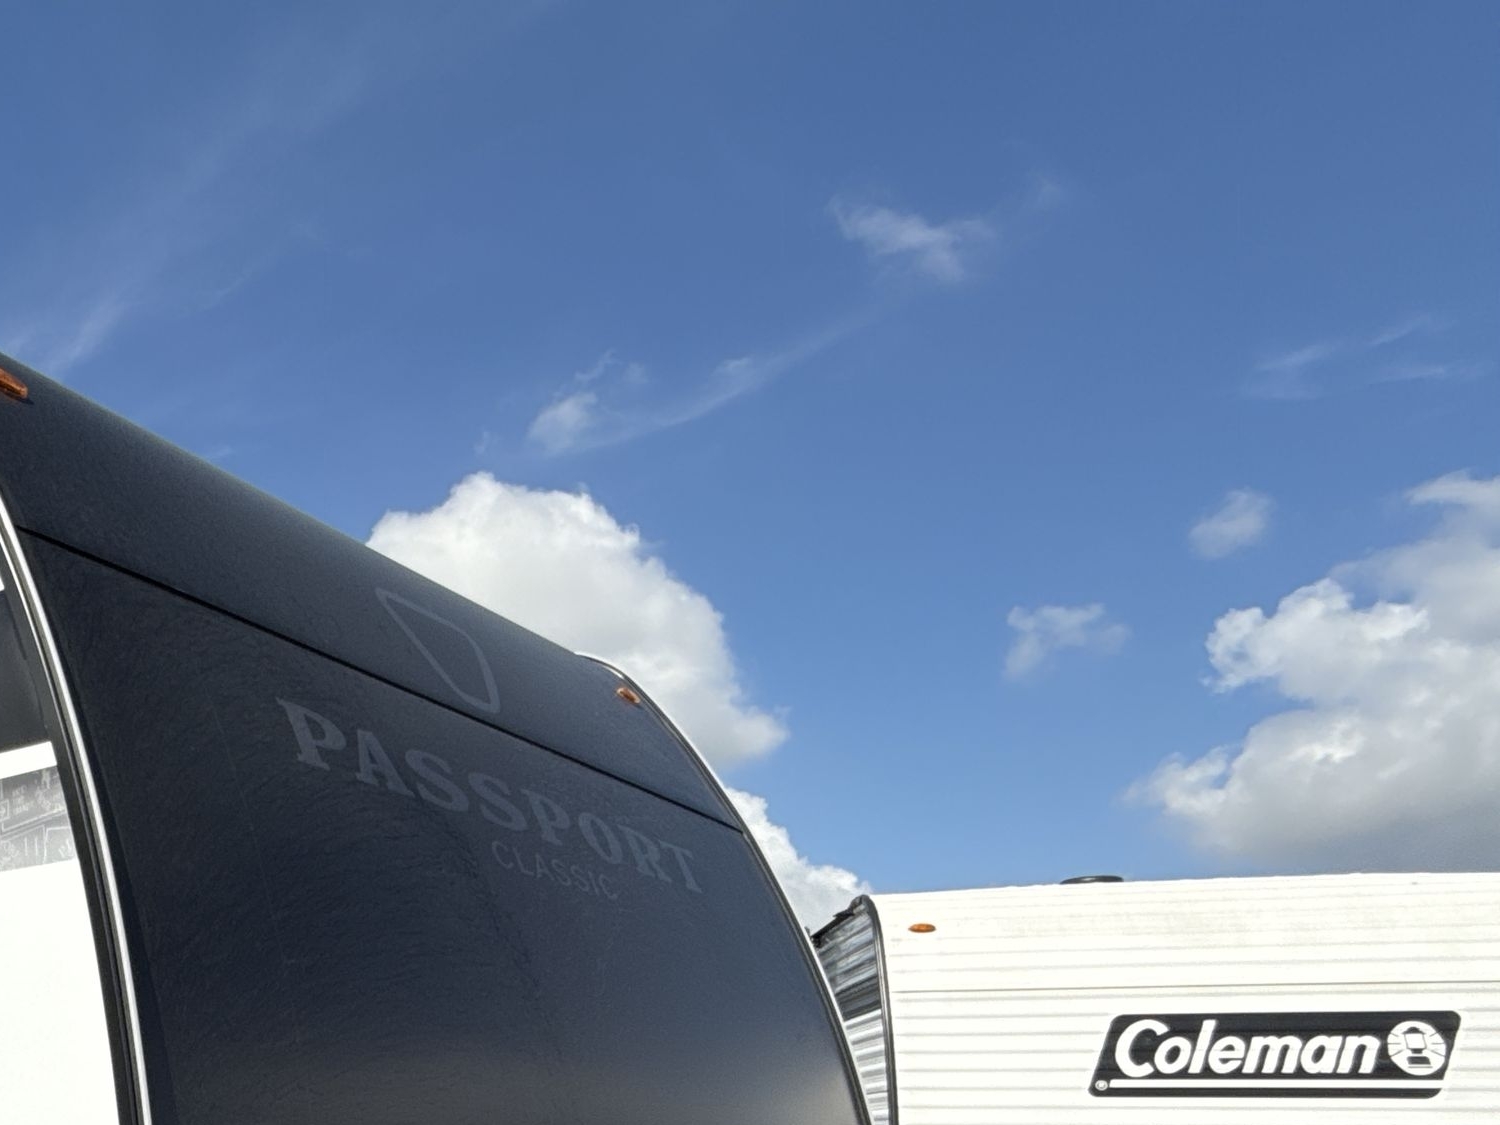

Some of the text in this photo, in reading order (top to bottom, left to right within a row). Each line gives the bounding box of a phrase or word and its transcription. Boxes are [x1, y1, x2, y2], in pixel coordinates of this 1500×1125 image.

[276, 697, 702, 893] PASSPORT
[491, 840, 620, 901] CLASSIC
[1115, 1019, 1381, 1078] Coleman
